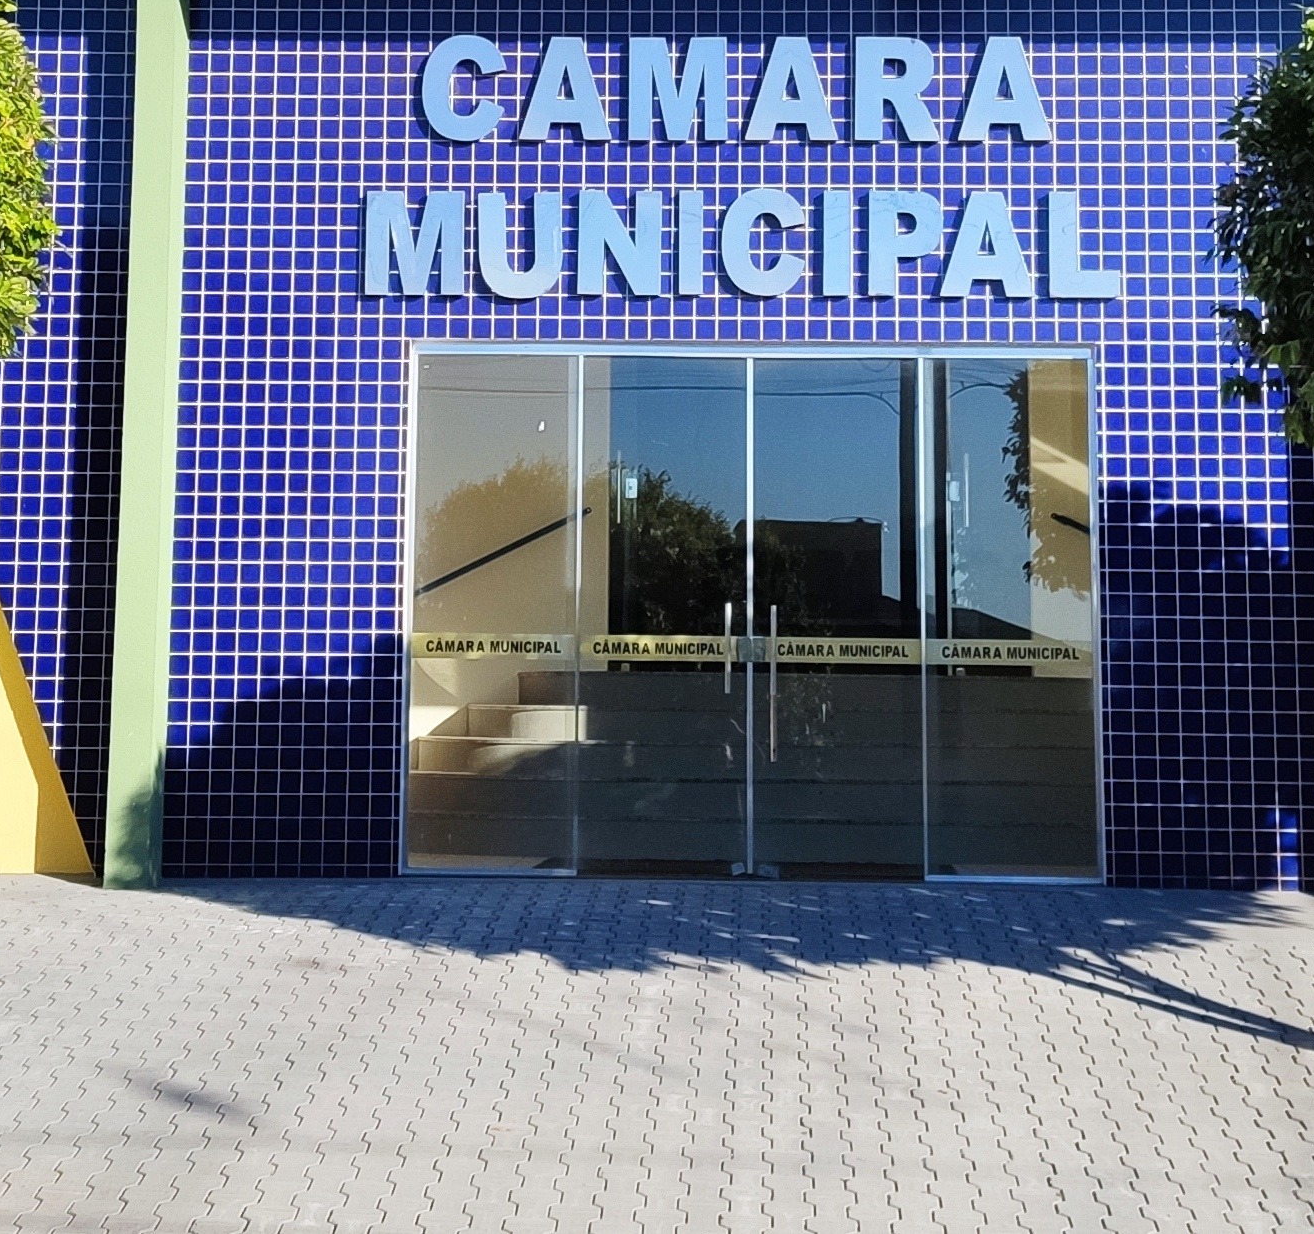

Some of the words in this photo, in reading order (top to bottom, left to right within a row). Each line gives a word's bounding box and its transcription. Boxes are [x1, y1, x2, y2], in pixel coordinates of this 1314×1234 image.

[421, 34, 1052, 142] CAMARA
[365, 188, 1121, 299] MUNICIPAL
[426, 638, 485, 653] CÂMARA
[489, 640, 562, 654] MUNICIPAL
[593, 639, 650, 655] CÂMARA
[654, 641, 724, 656] MUNICIPAL
[777, 641, 835, 658] CÂMARA
[839, 644, 909, 658] MUNICIPAL
[942, 643, 1002, 660] CÂMARA
[1006, 646, 1080, 661] MUNICIPAL
